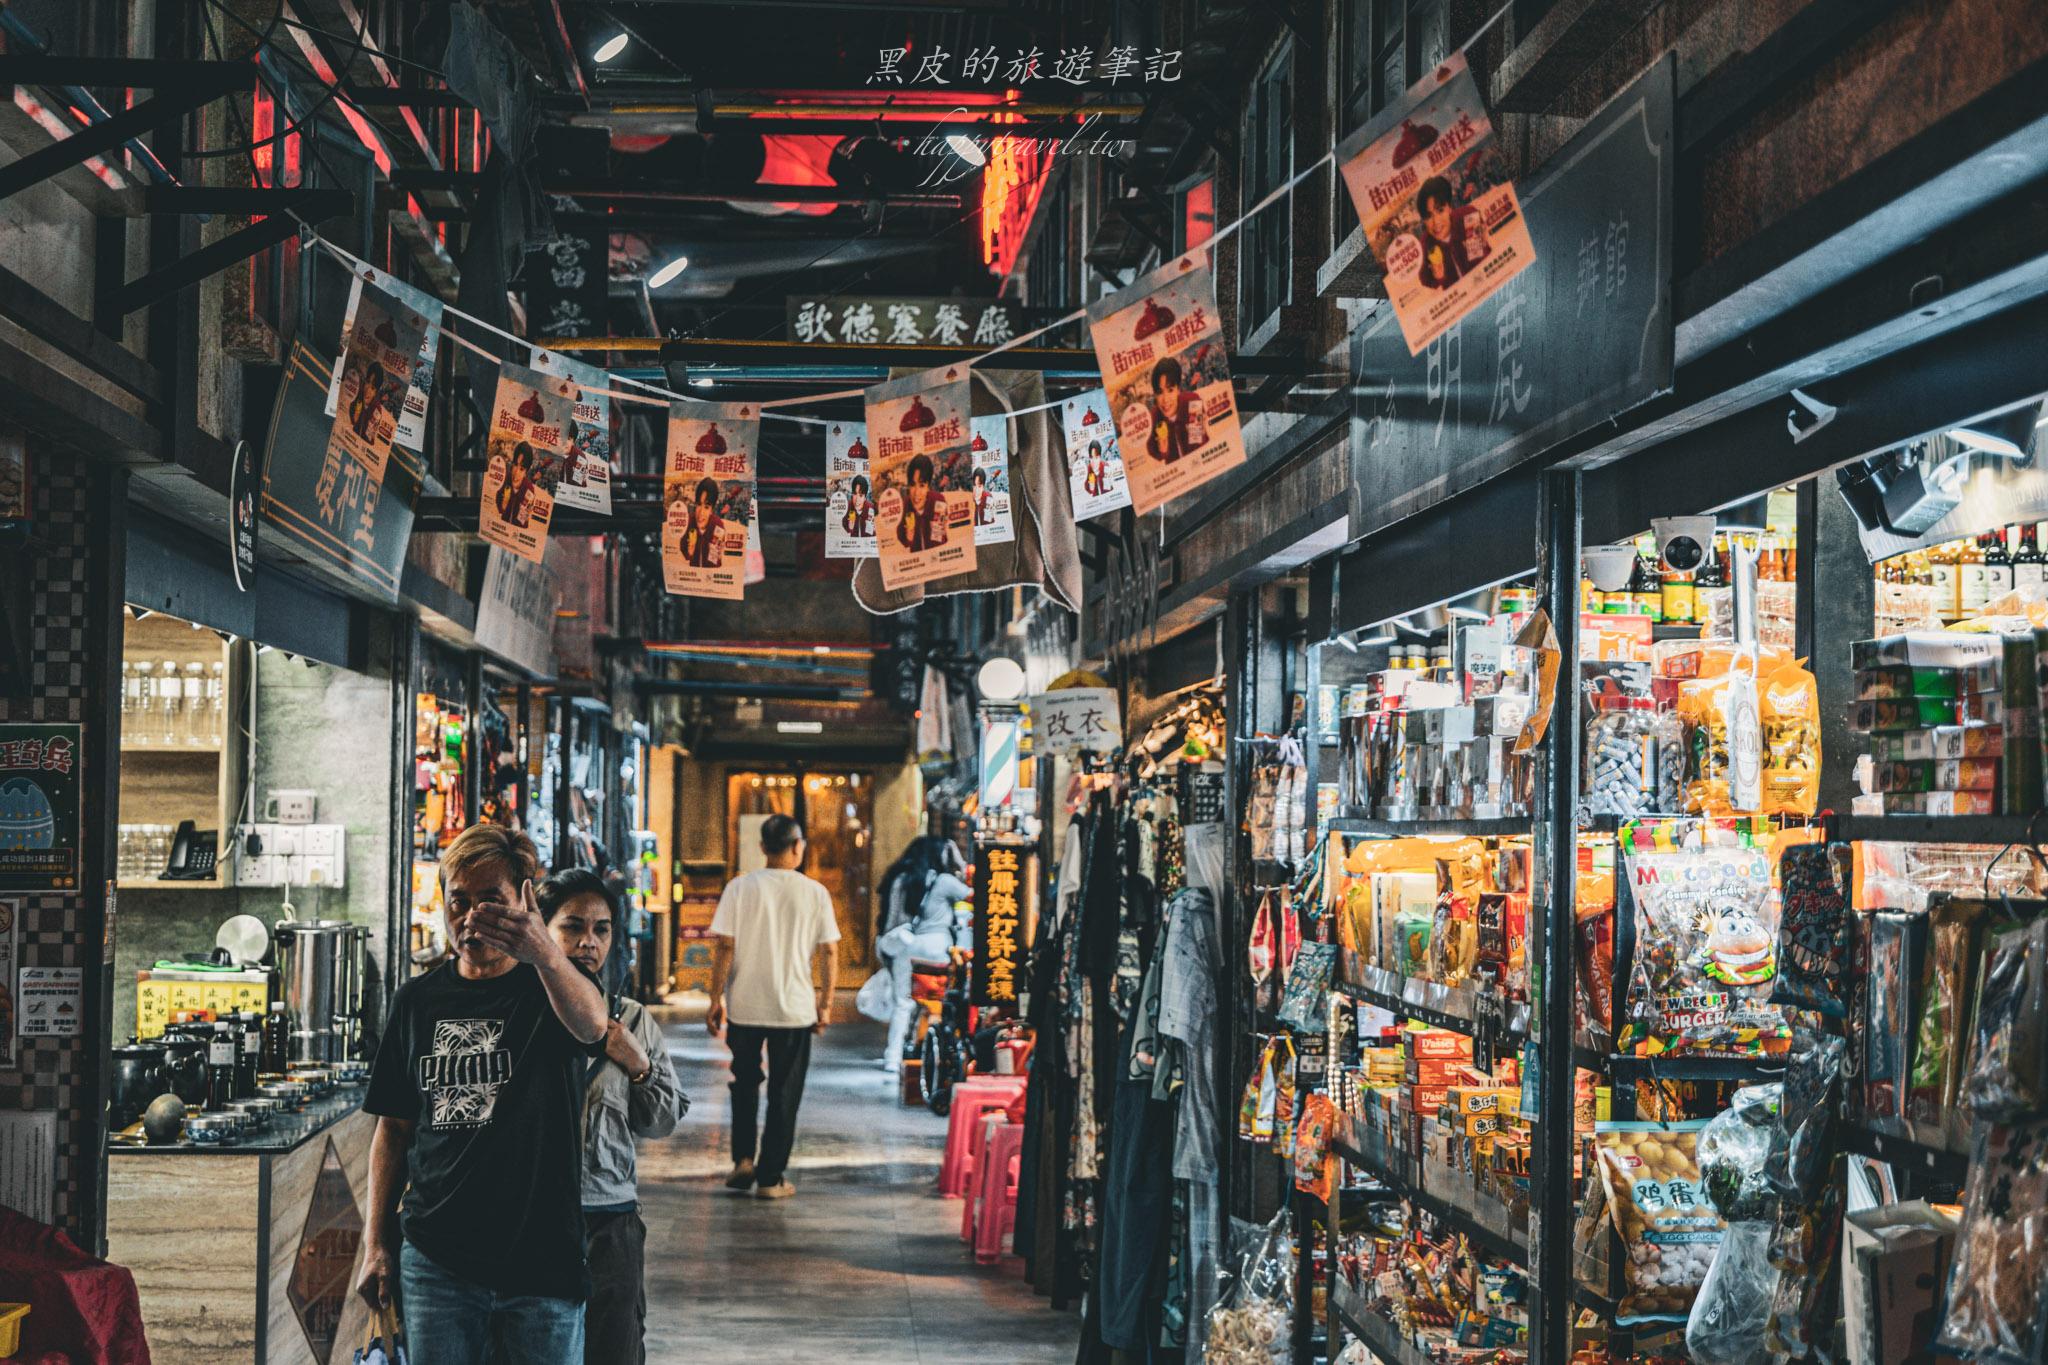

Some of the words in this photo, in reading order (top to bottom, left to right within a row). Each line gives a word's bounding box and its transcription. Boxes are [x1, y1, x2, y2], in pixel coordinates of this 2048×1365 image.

[1427, 113, 1475, 166] 新鮮送
[1165, 308, 1206, 348] 新鮮送
[531, 424, 561, 446] 新鮮送
[924, 417, 960, 447] 新鮮送
[714, 452, 746, 474] 新鮮送
[1046, 708, 1108, 737] 改衣
[1683, 992, 1729, 1008] RECIPE
[1660, 1233, 1685, 1241] EGG
[1687, 1233, 1718, 1241] CAKE
